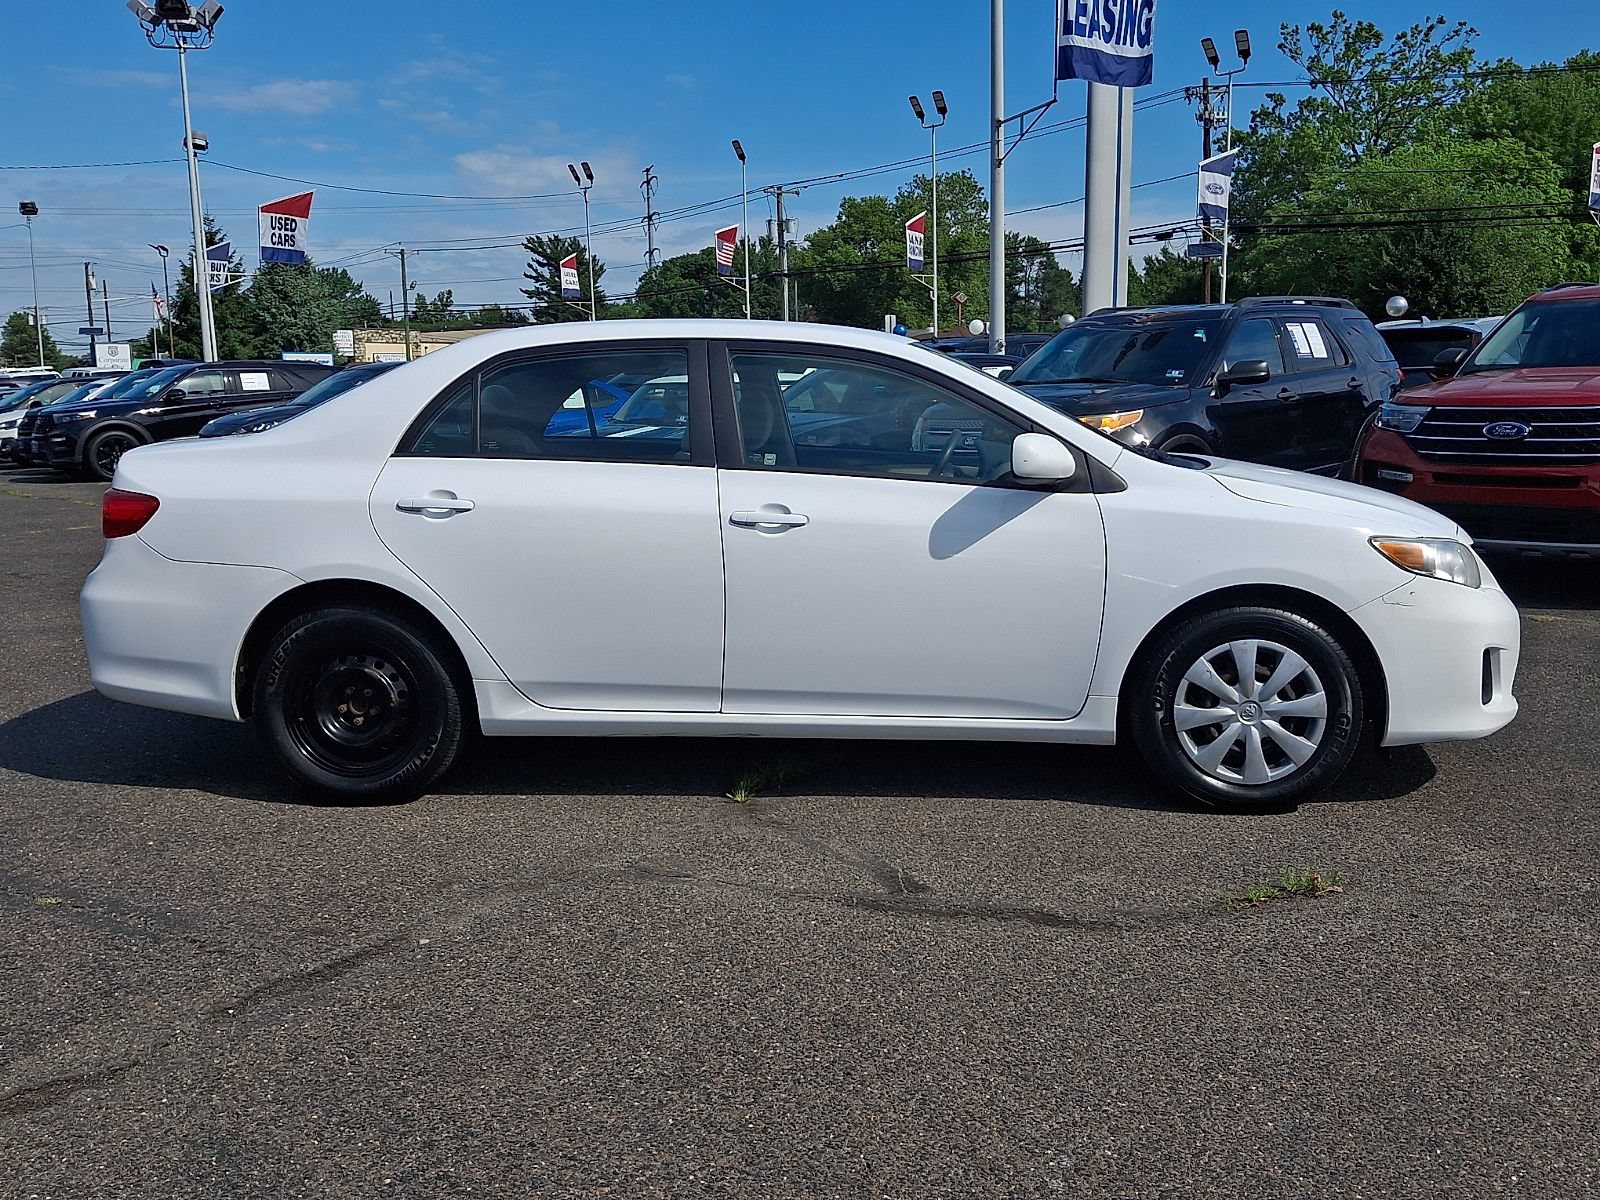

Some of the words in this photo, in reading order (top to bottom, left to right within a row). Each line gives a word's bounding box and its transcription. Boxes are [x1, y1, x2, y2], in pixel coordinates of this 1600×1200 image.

[1062, 0, 1154, 49] LEASING
[270, 216, 298, 232] USED
[270, 232, 296, 247] CARS
[210, 262, 227, 272] BUY
